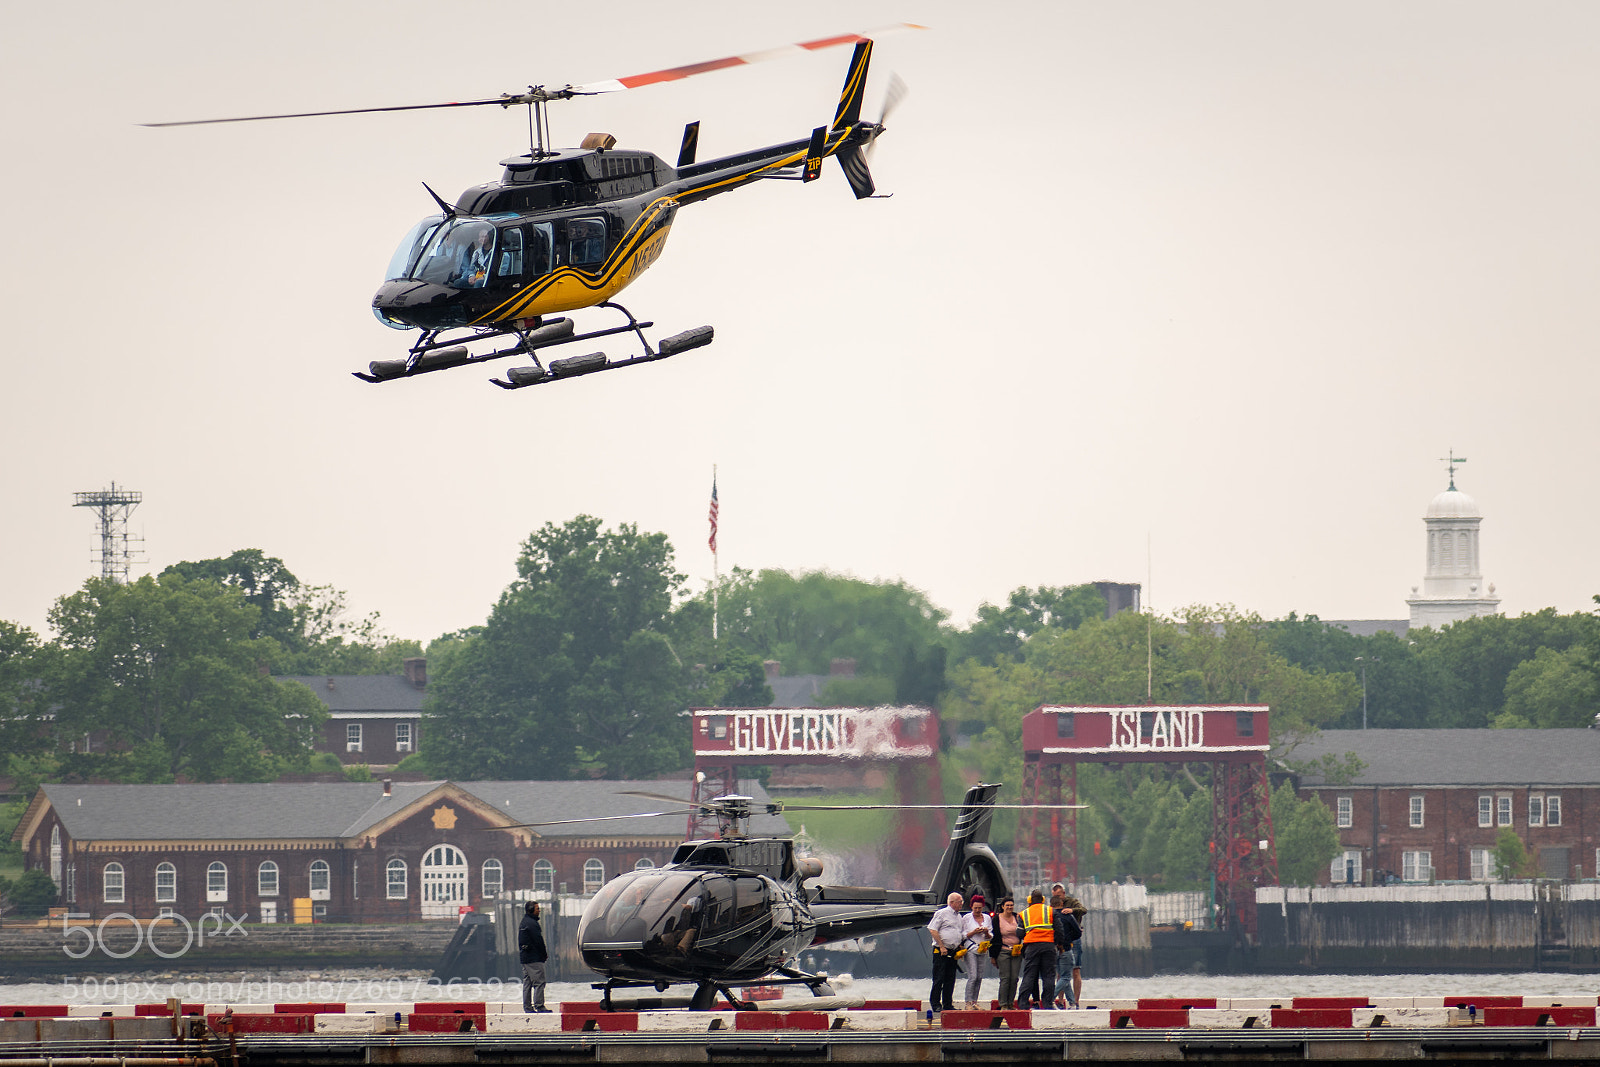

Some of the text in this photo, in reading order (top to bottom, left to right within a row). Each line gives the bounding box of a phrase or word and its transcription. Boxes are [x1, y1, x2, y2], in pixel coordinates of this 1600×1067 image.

[808, 160, 821, 171] ZIP
[1109, 710, 1204, 749] ISLAND
[735, 842, 786, 866] N131TD
